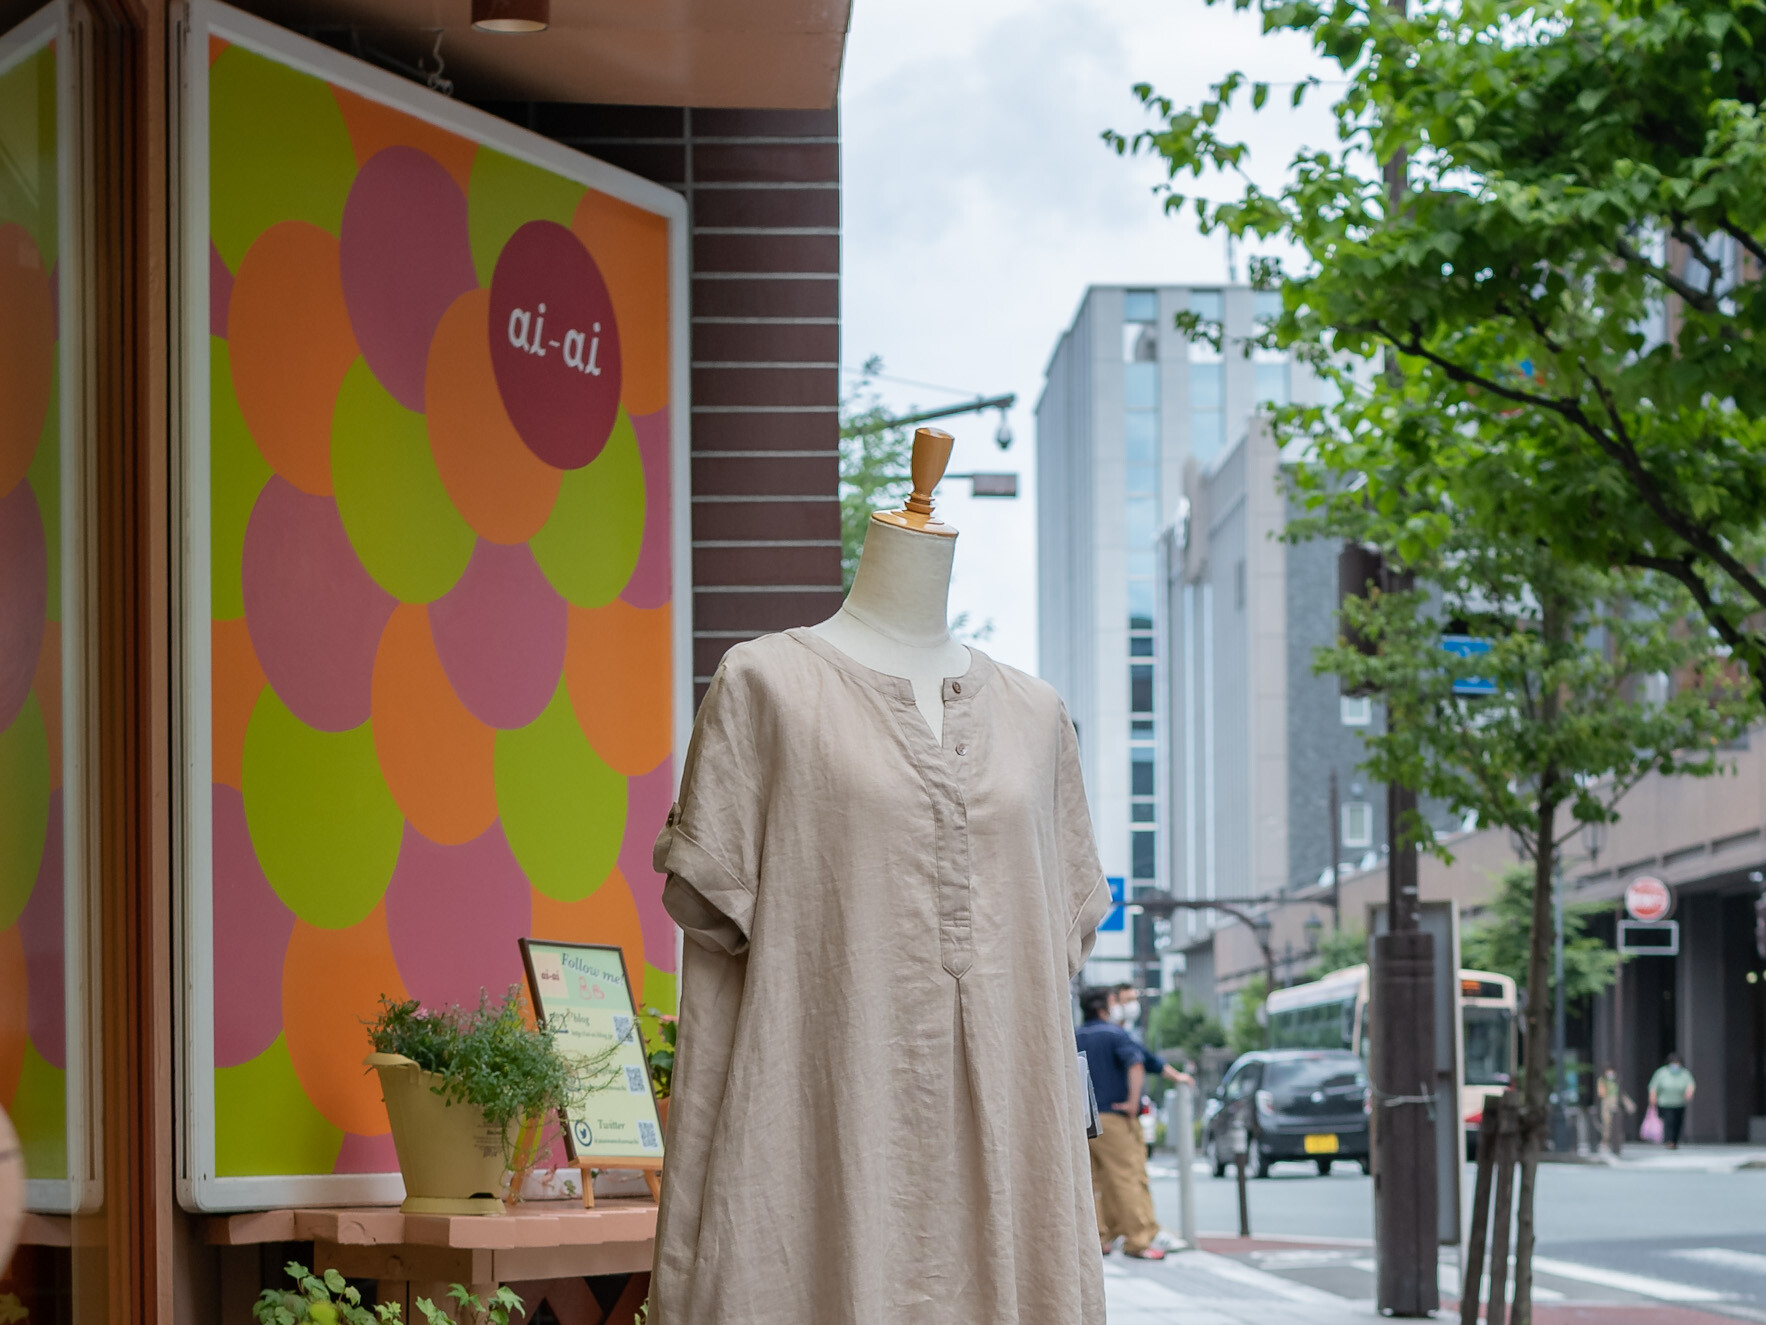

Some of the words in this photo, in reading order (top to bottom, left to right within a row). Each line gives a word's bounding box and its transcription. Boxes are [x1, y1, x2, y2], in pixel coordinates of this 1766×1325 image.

[507, 302, 602, 376] ai-ai
[562, 953, 599, 977] Follow
[541, 969, 560, 980] ai-ai
[598, 1119, 626, 1130] Twitter
